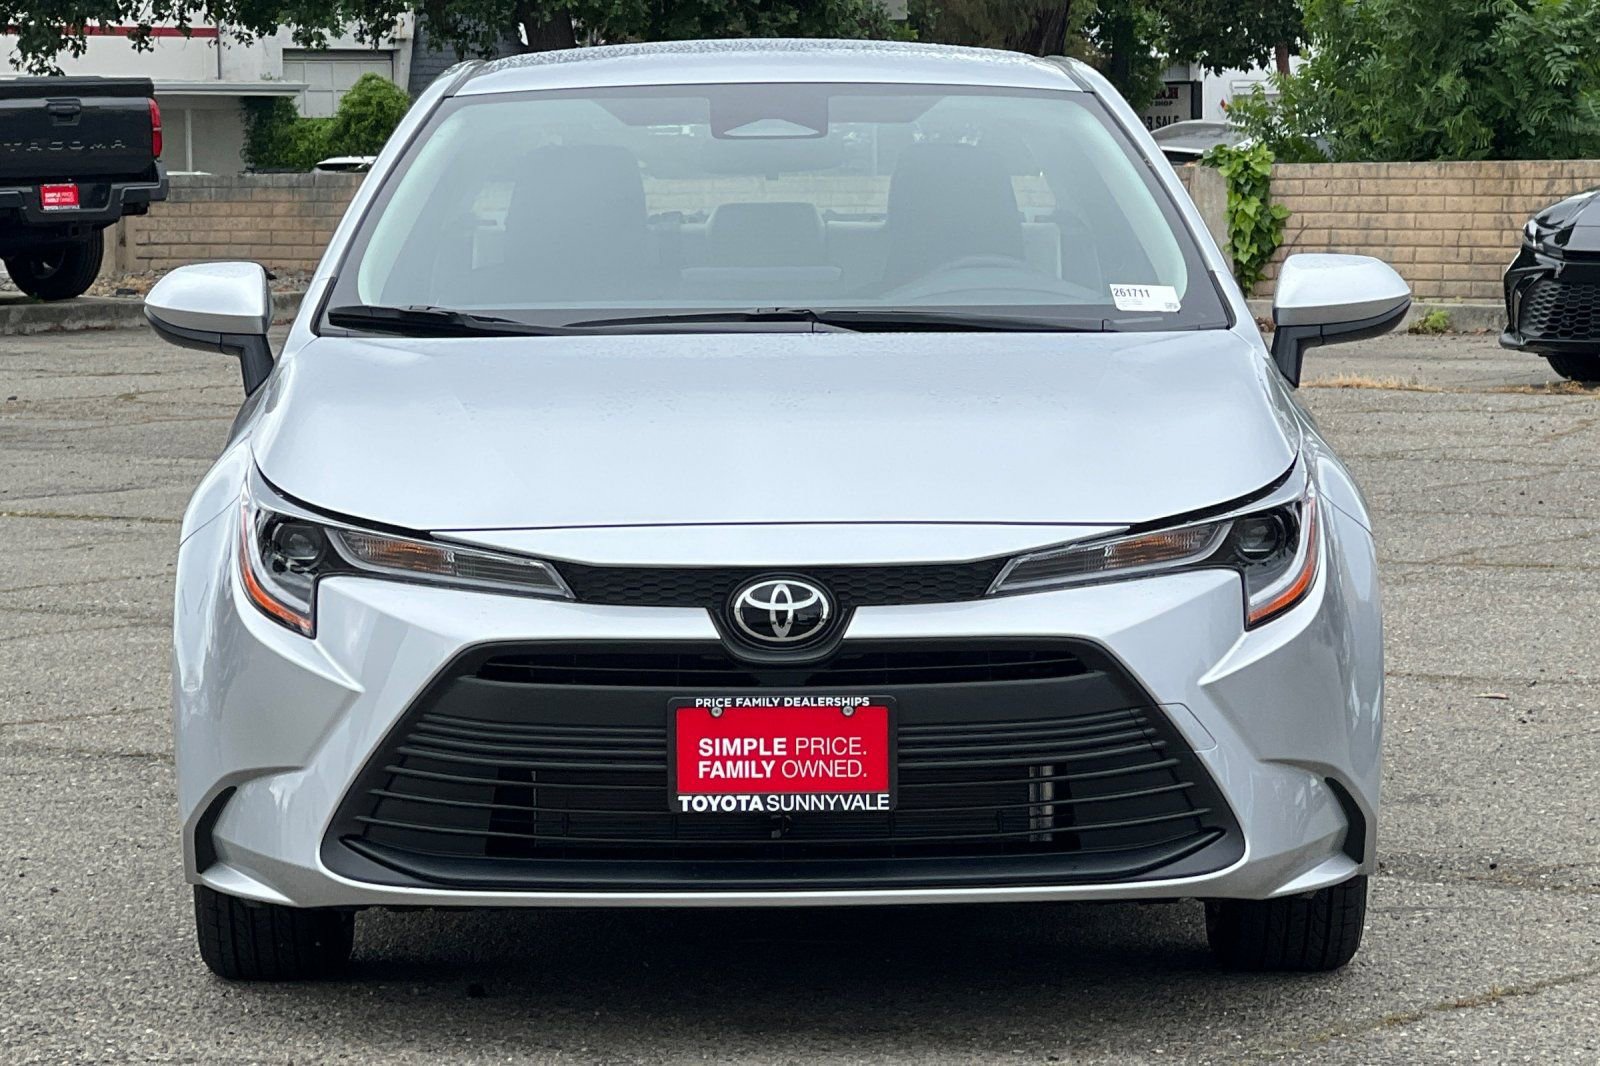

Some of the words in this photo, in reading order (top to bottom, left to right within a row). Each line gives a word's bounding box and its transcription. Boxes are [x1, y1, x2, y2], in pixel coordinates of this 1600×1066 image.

[3, 139, 126, 152] TACOMA
[1113, 287, 1150, 298] 261711
[695, 698, 732, 708] PRICE
[735, 697, 780, 708] FAMILY
[783, 696, 870, 707] DEALERSHIPS
[698, 737, 787, 757] SIMPLE
[795, 737, 867, 756] PRICE.
[698, 760, 776, 779] FAMILY
[781, 759, 868, 779] OWNED.
